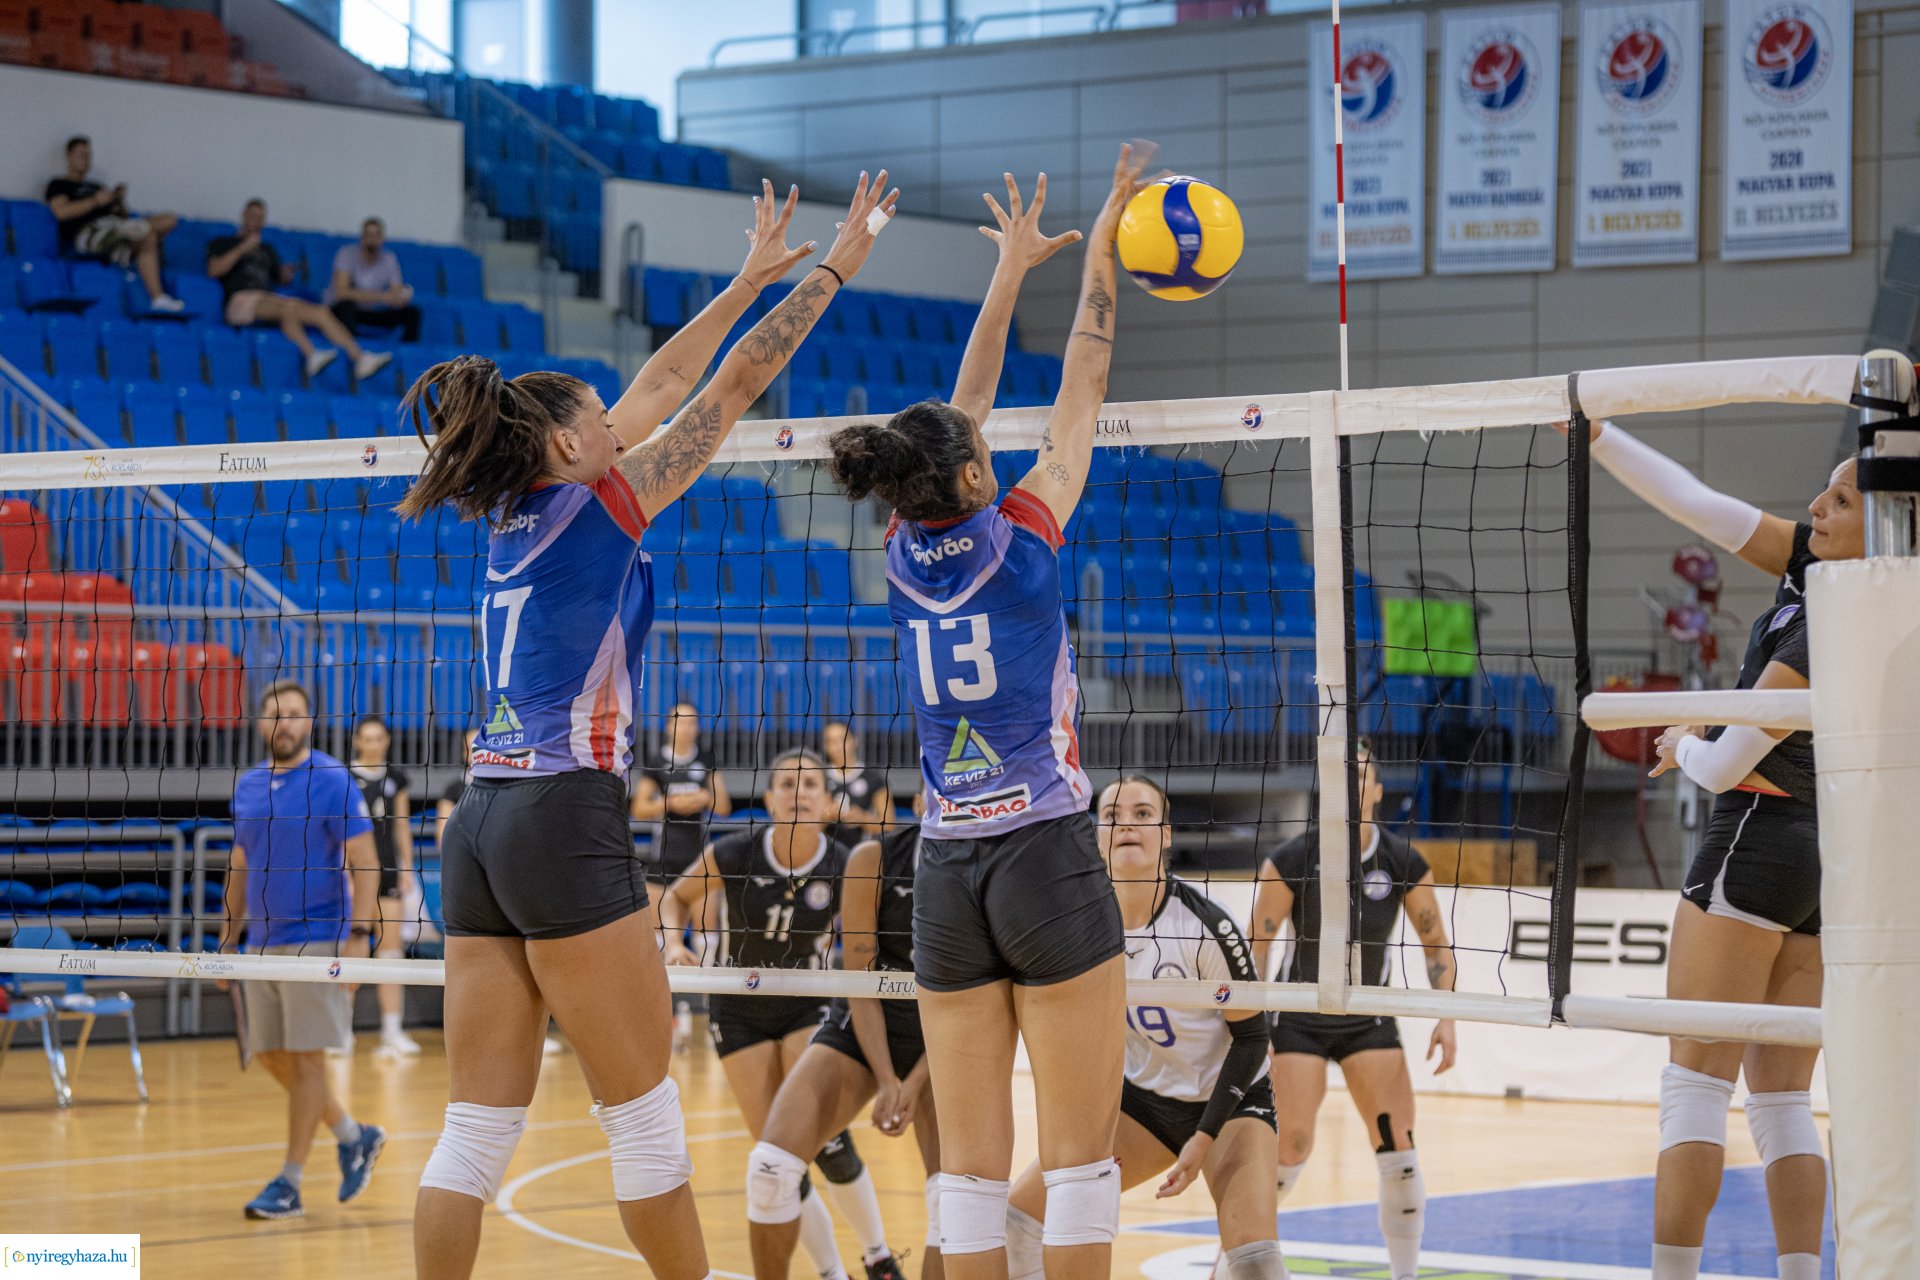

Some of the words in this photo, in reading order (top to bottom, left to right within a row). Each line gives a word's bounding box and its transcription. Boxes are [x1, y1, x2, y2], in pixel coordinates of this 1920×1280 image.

[1738, 176, 1795, 194] MAGYAR
[1095, 419, 1132, 435] TUM
[219, 452, 267, 471] FATUM
[907, 612, 998, 706] 13
[514, 731, 524, 744] 21
[944, 770, 988, 786] KE-VIZ
[989, 765, 1005, 777] 21
[764, 903, 795, 942] 11
[59, 953, 97, 969] FATUM
[877, 976, 916, 993] FATU
